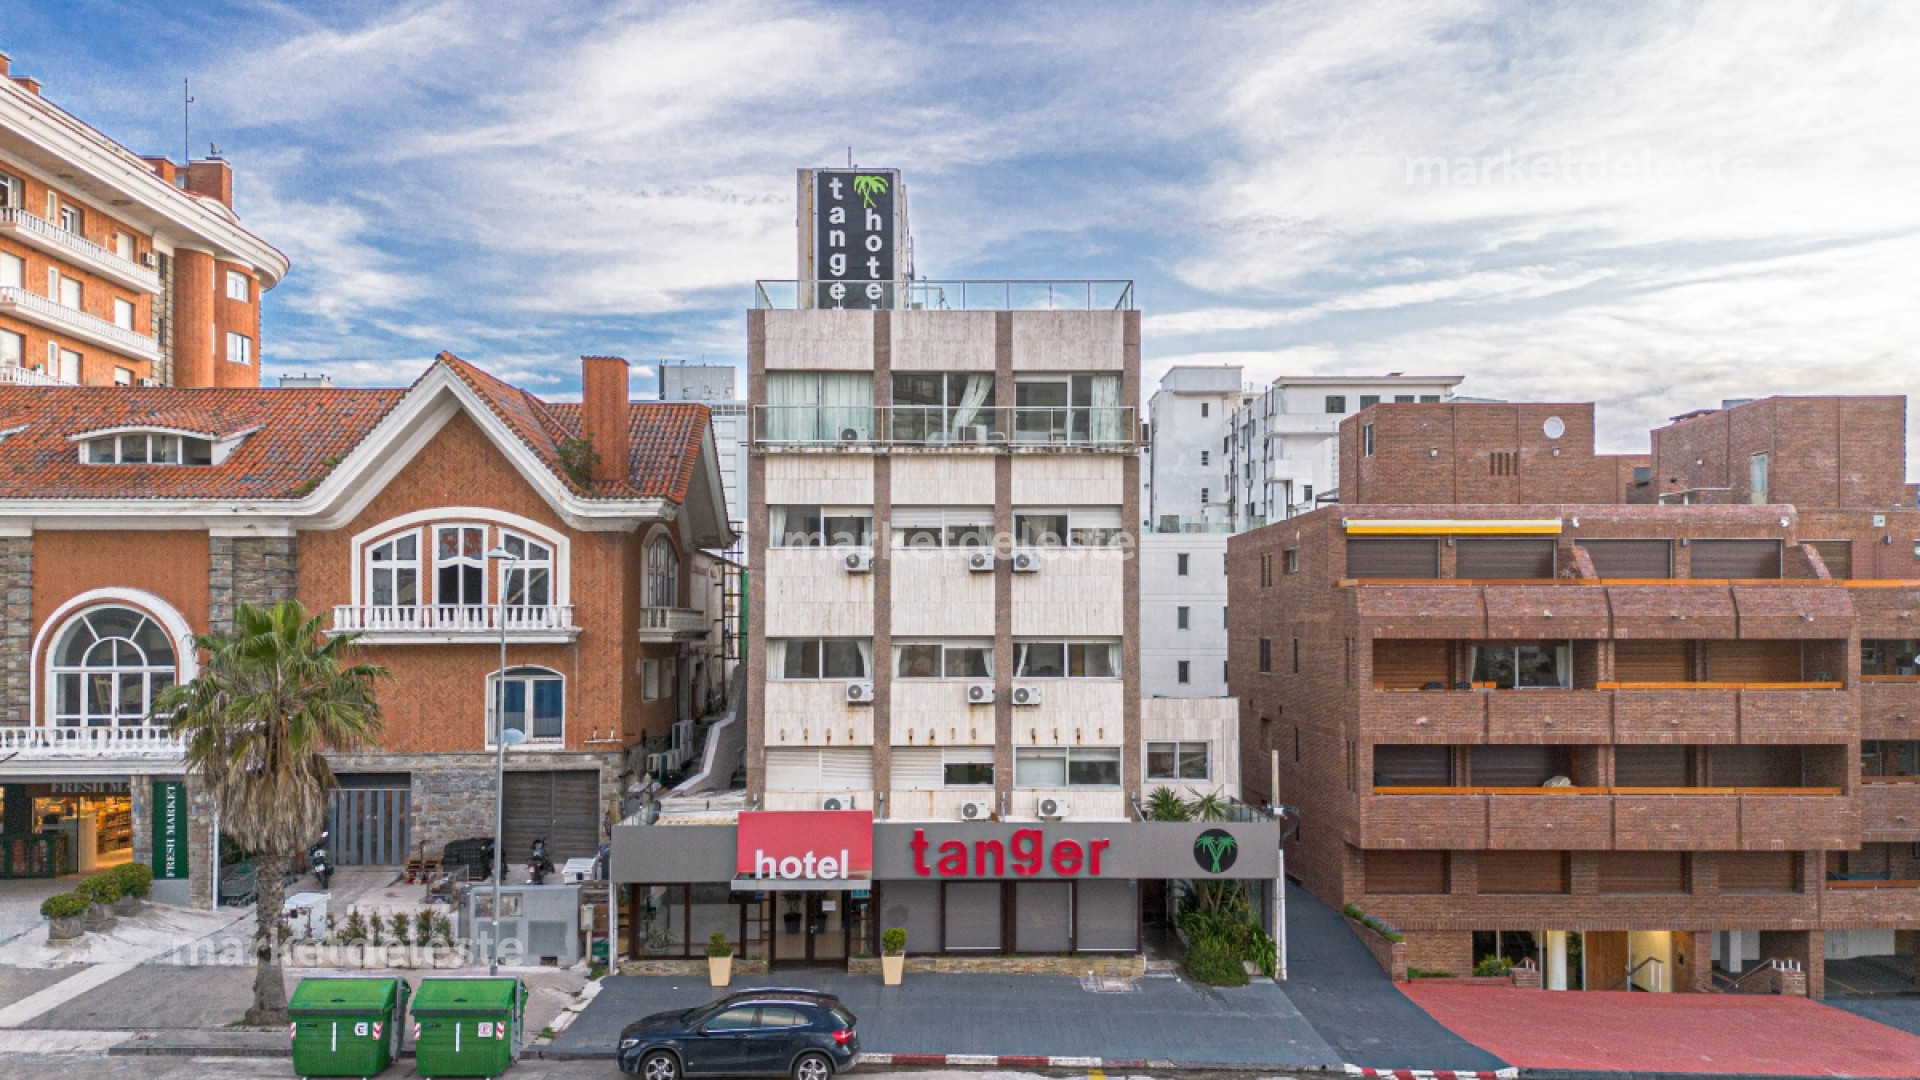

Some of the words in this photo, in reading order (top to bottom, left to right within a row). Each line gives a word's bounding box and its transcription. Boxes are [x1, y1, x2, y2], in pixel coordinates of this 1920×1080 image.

[829, 177, 846, 310] tange
[165, 783, 176, 836] MARKET
[165, 837, 176, 878] FRESH
[756, 849, 848, 879] hotel
[910, 827, 1110, 877] tanger
